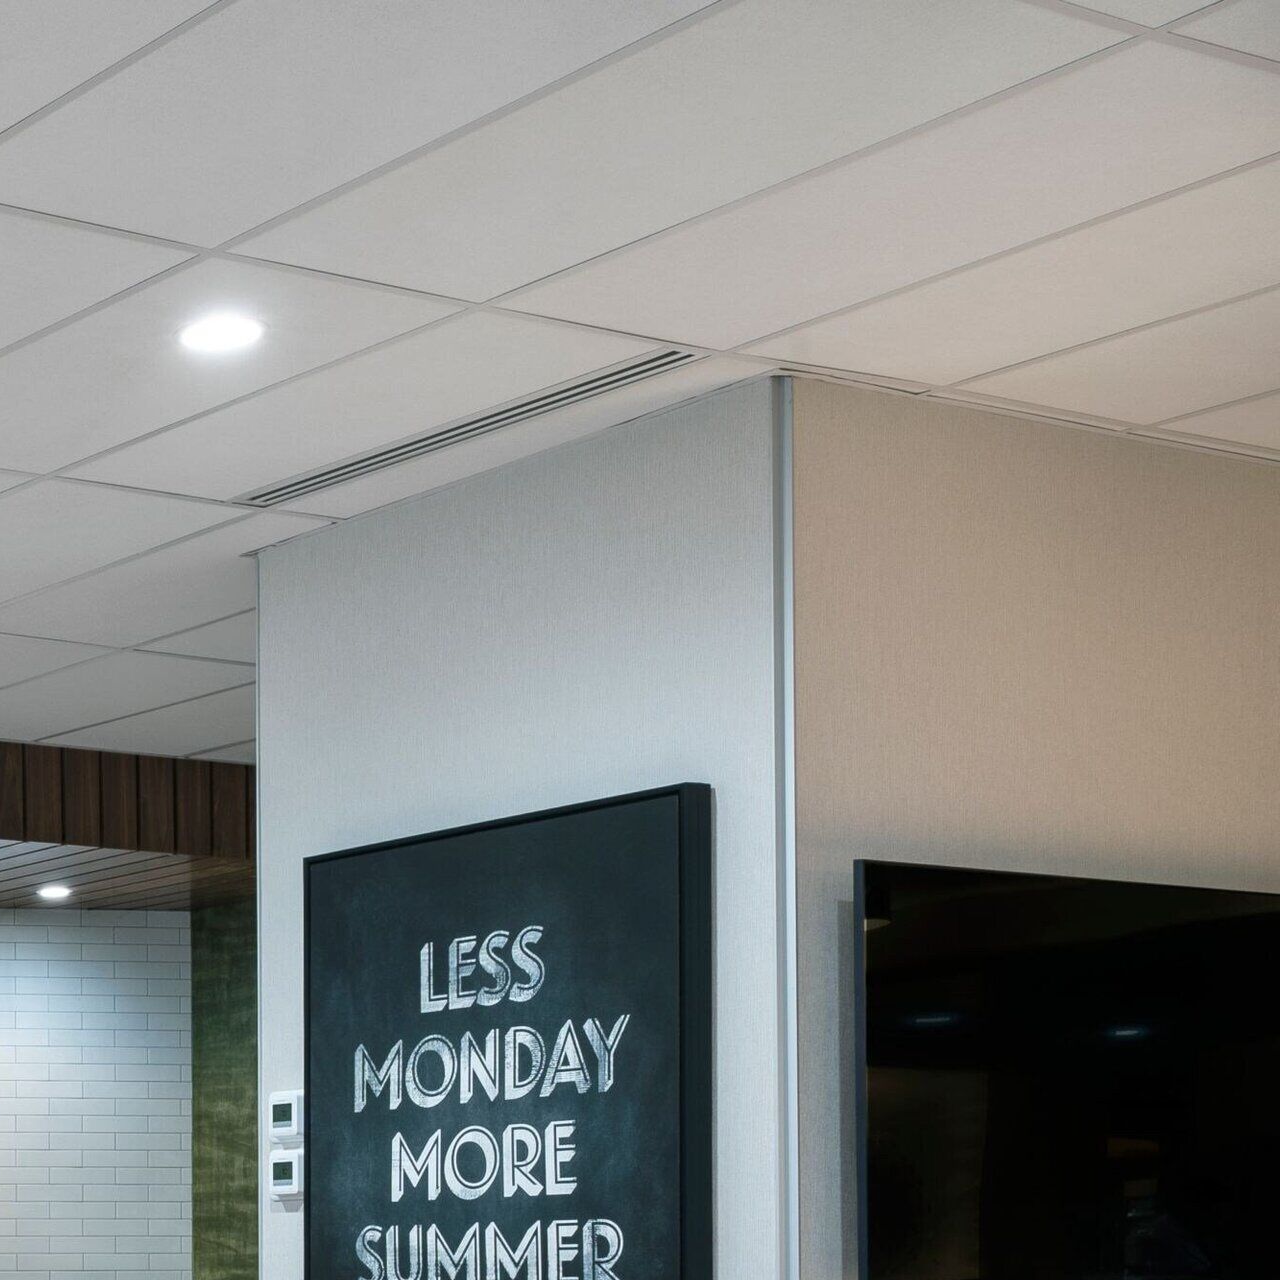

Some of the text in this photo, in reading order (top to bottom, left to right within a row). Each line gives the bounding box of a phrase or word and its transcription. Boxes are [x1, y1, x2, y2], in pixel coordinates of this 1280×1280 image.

[420, 925, 545, 1013] LESS
[354, 1013, 630, 1113] MONDAY
[391, 1119, 577, 1202] MORE
